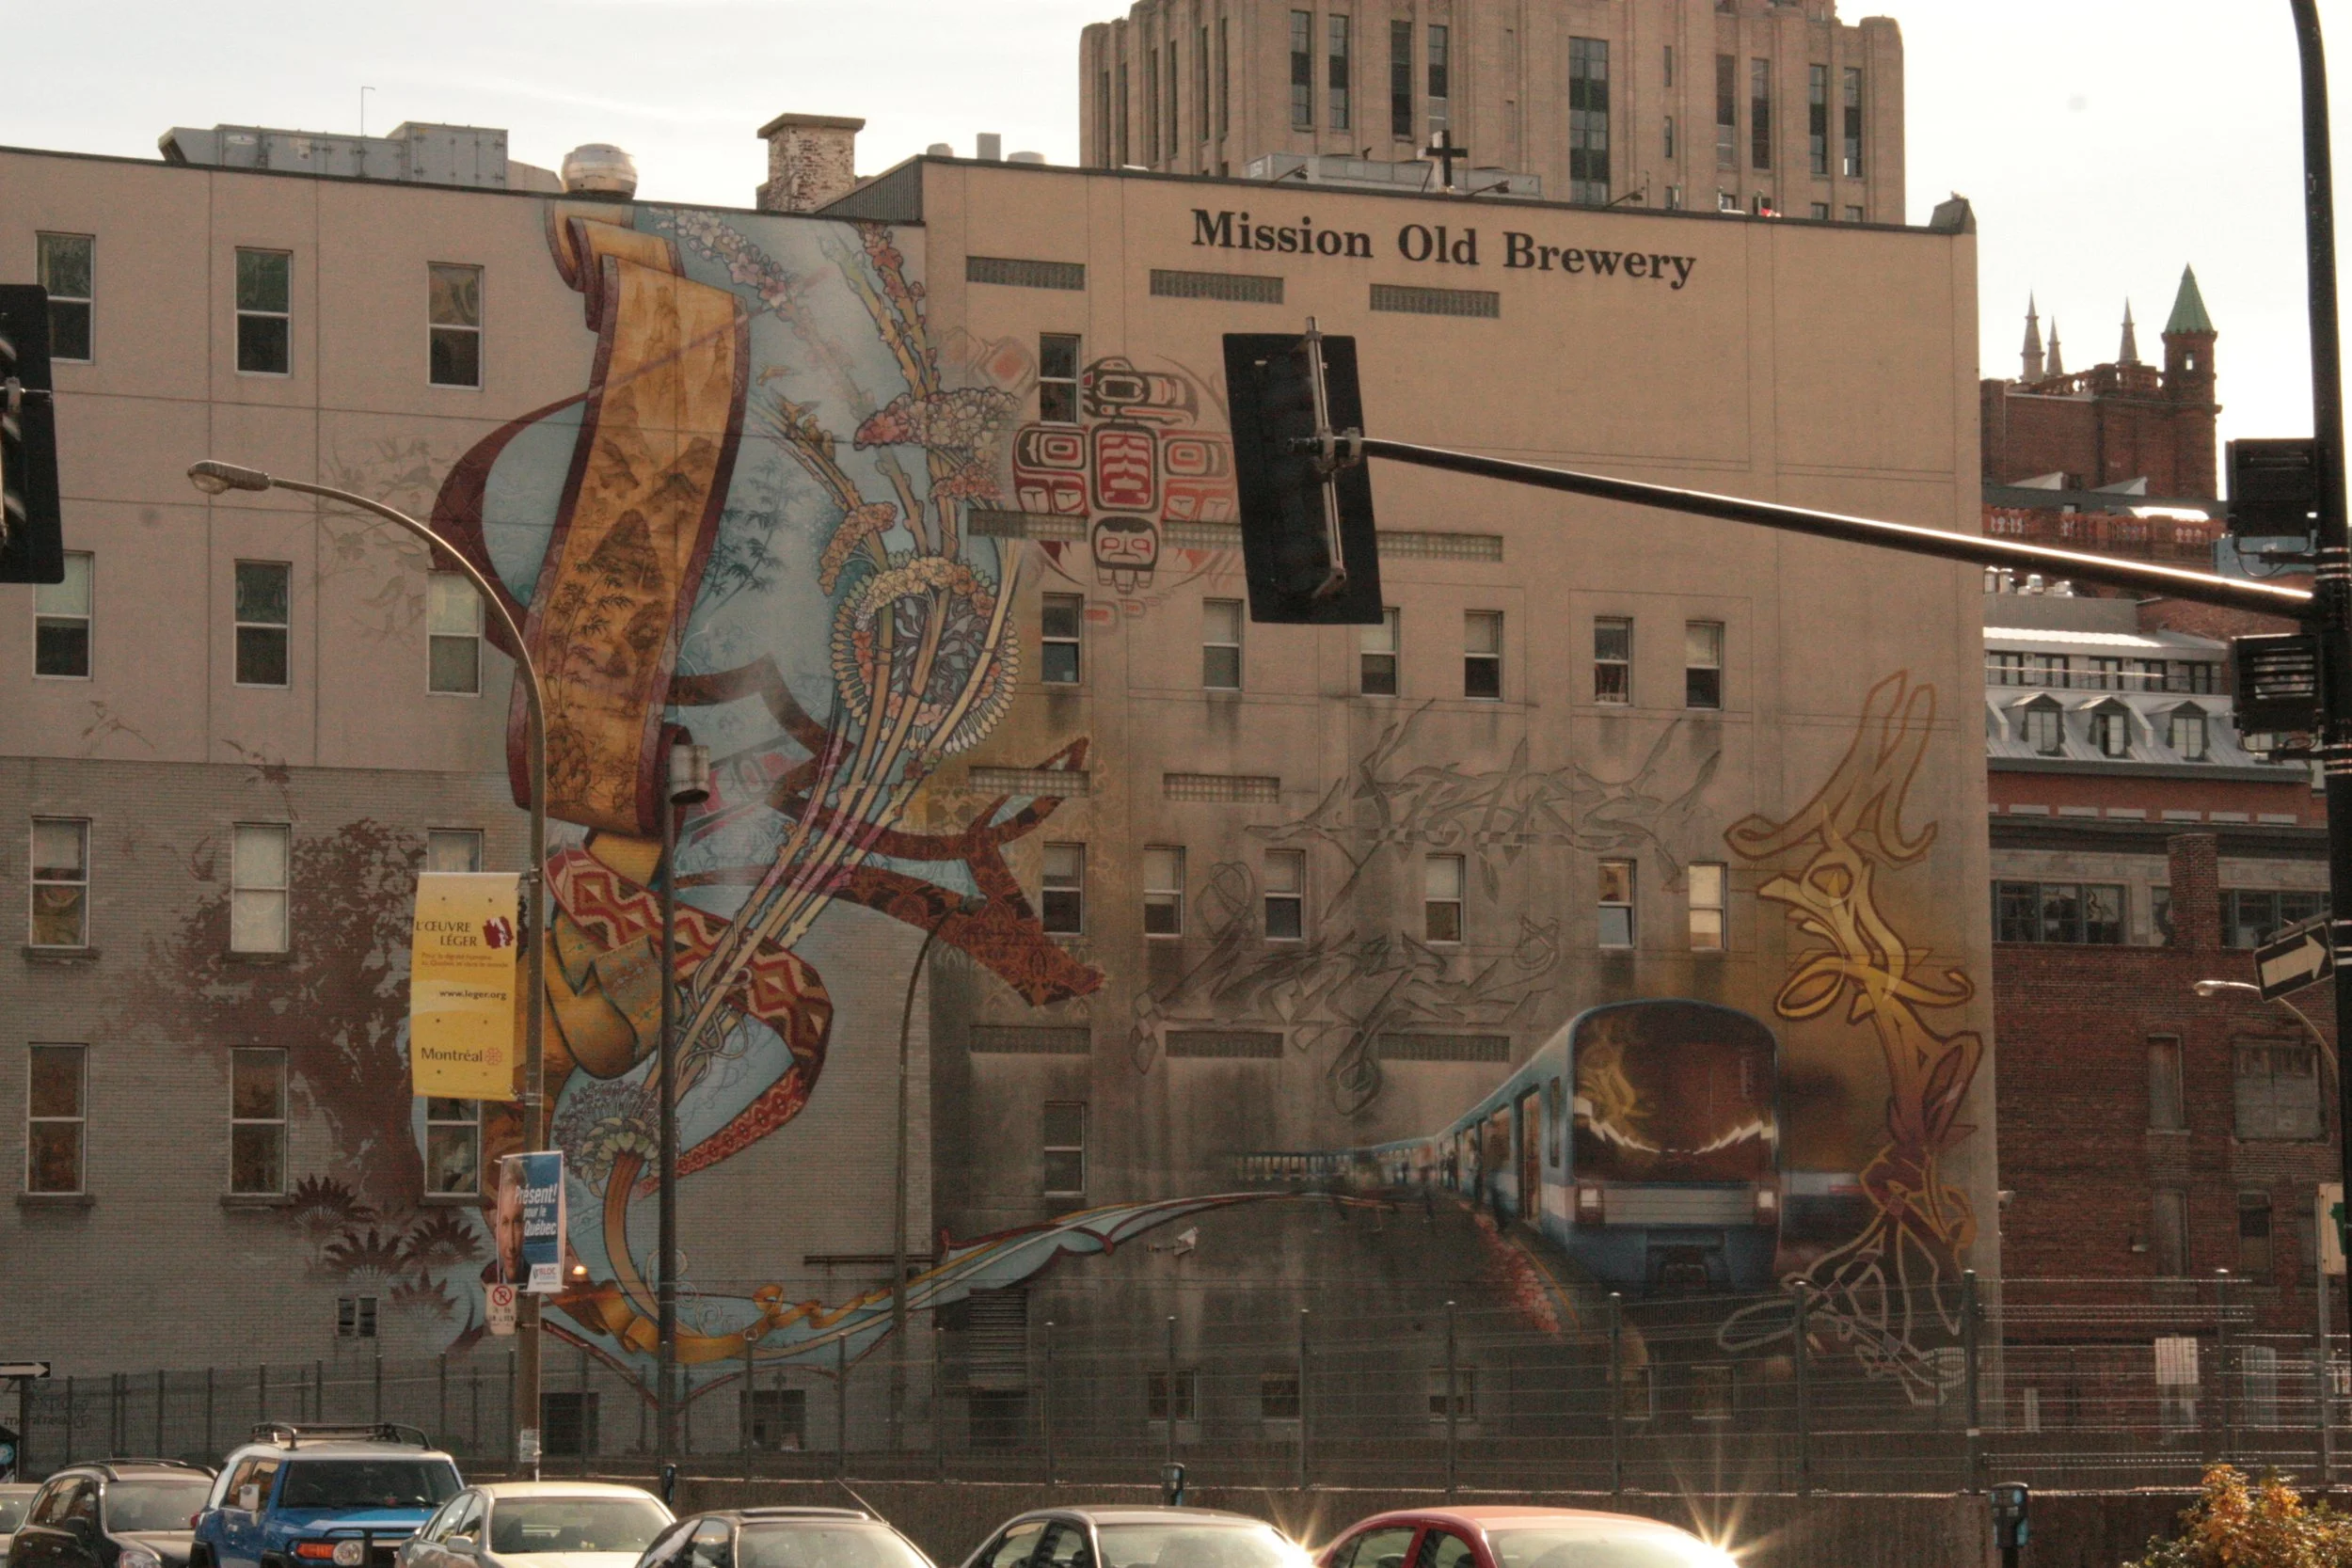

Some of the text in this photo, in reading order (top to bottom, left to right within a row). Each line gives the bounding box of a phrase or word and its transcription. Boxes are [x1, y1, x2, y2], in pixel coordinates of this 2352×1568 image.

[1191, 208, 1697, 290] Mission Old Brewery
[439, 933, 478, 947] LÉGER
[438, 990, 507, 1001] www.leger.org
[421, 1047, 483, 1062] Montréal
[515, 1183, 557, 1204] Présent!
[523, 1205, 548, 1220] pour le
[524, 1221, 557, 1237] Québec
